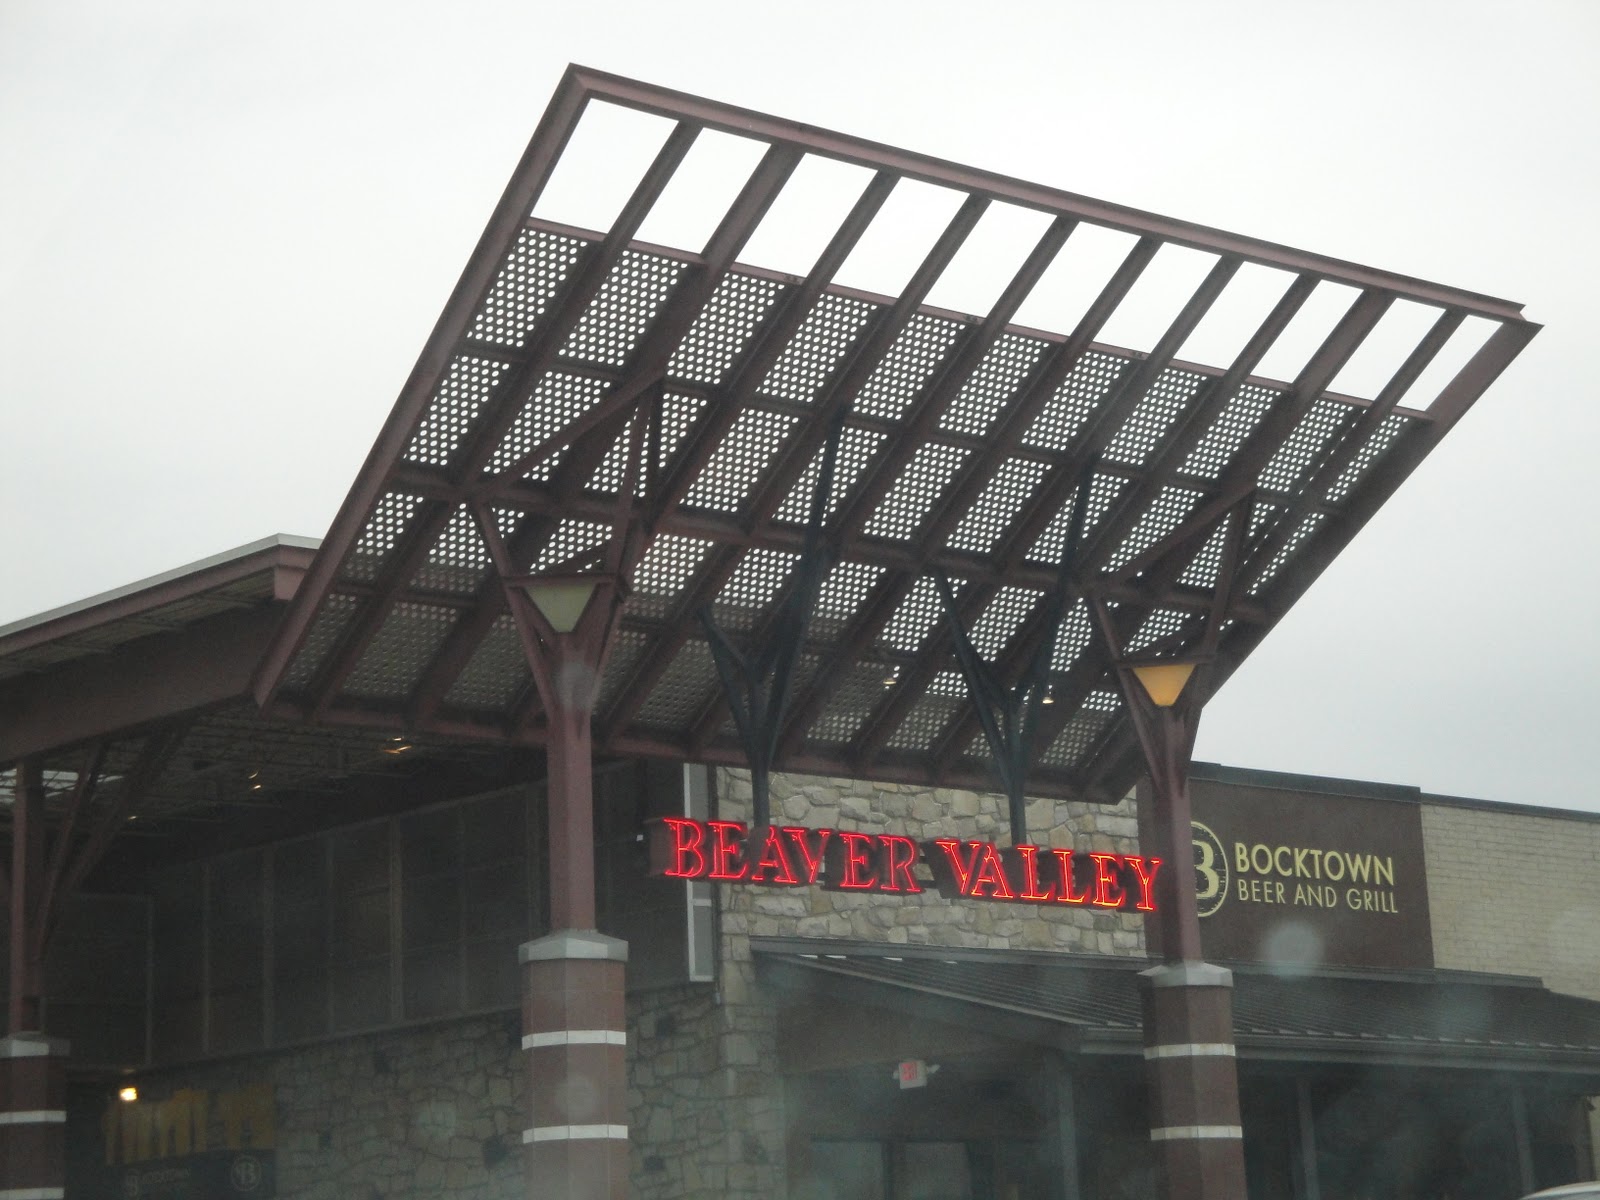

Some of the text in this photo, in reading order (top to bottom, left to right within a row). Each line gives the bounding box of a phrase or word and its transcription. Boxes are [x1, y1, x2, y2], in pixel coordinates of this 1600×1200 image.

[663, 817, 1163, 911] BEAVER VALLEY
[1234, 842, 1395, 886] BOCKTOWN
[1238, 879, 1399, 914] BEER AND GRILL
